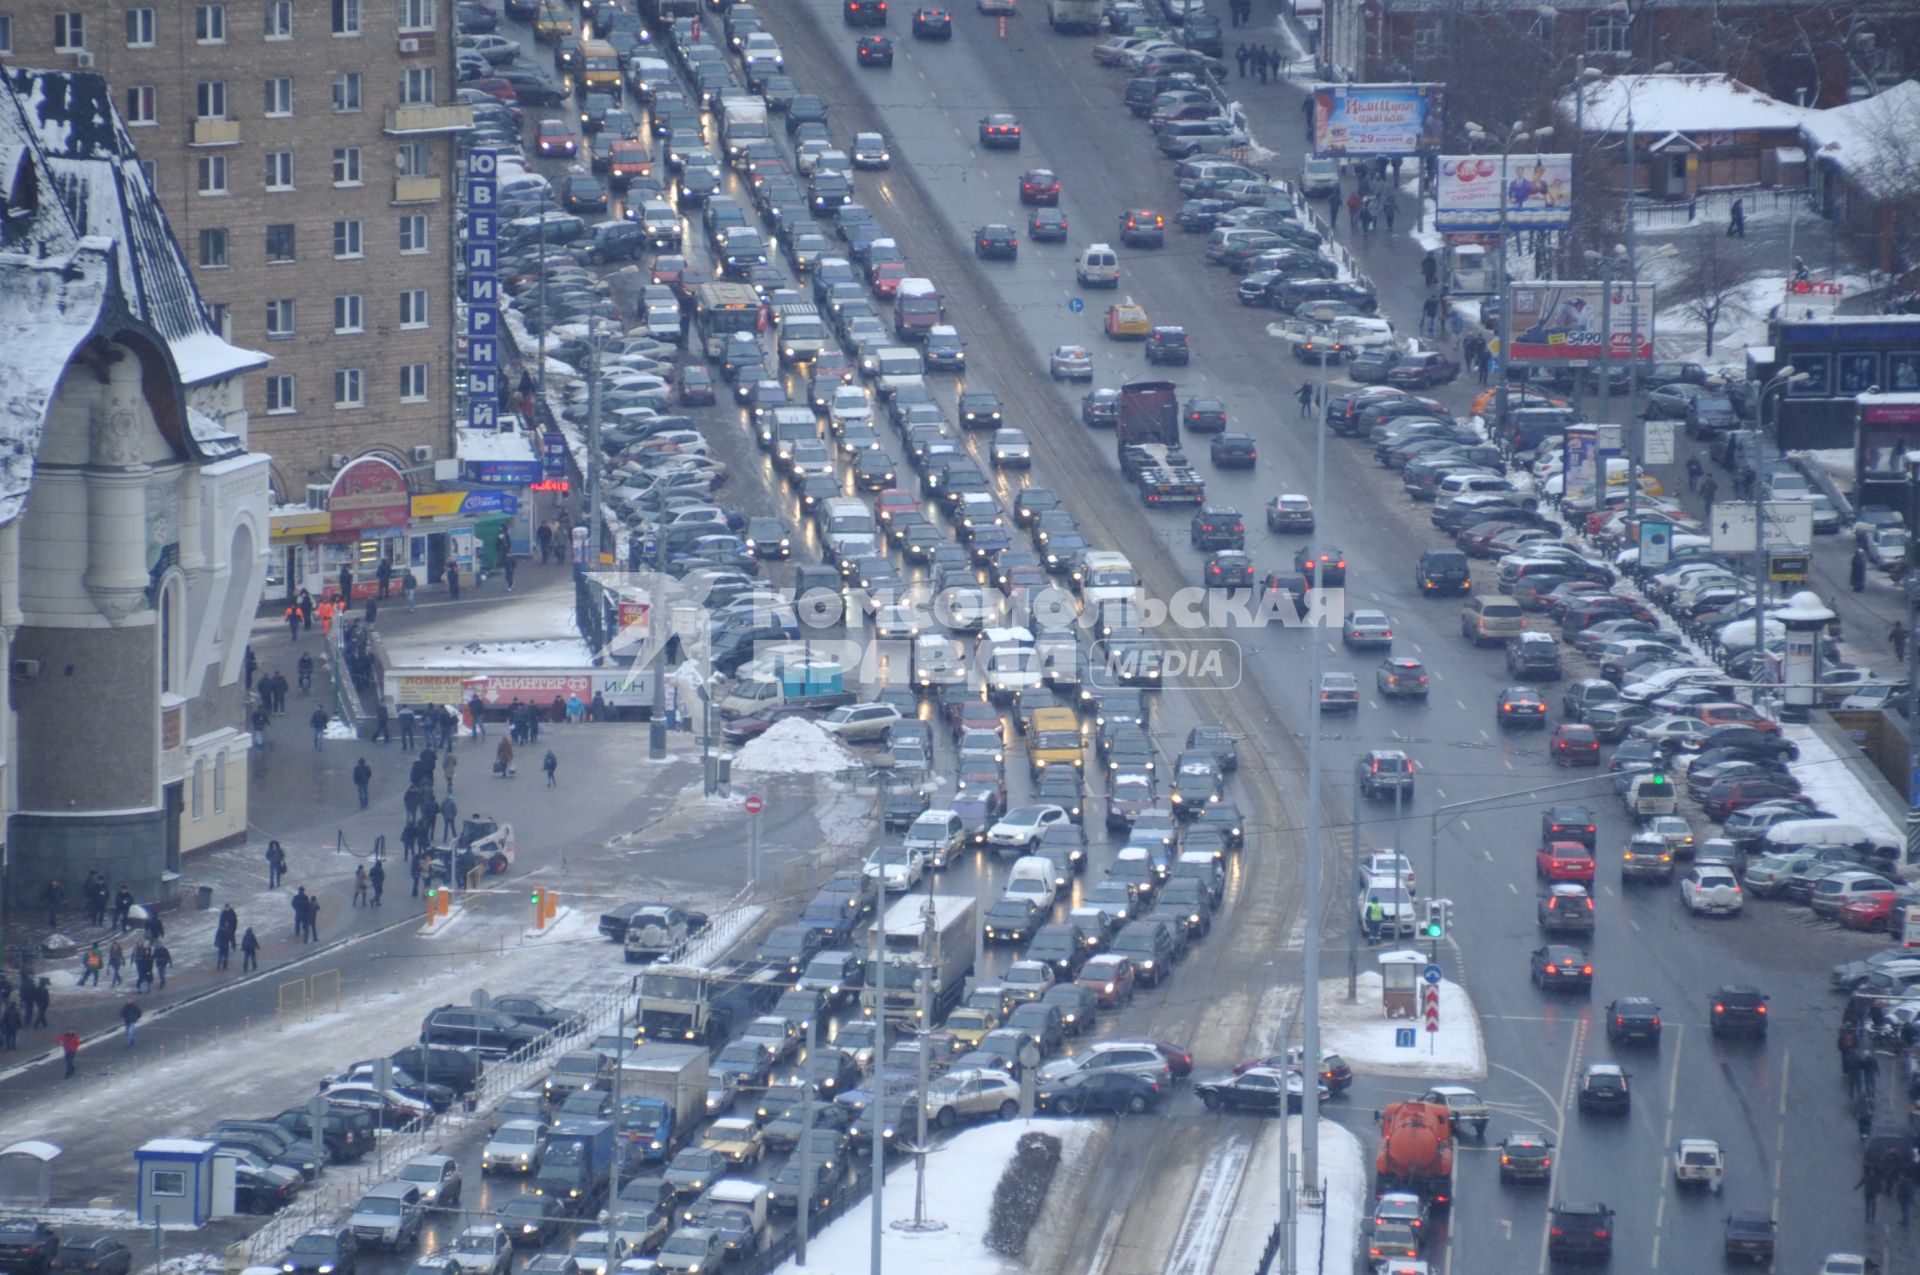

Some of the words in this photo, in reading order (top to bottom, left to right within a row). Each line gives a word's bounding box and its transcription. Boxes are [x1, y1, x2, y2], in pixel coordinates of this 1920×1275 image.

[1360, 134, 1374, 143] 29
[470, 154, 495, 425] ЮВЕЛИРНЫЙ
[1567, 332, 1602, 344] 5490
[406, 676, 463, 686] ЛОМБАР
